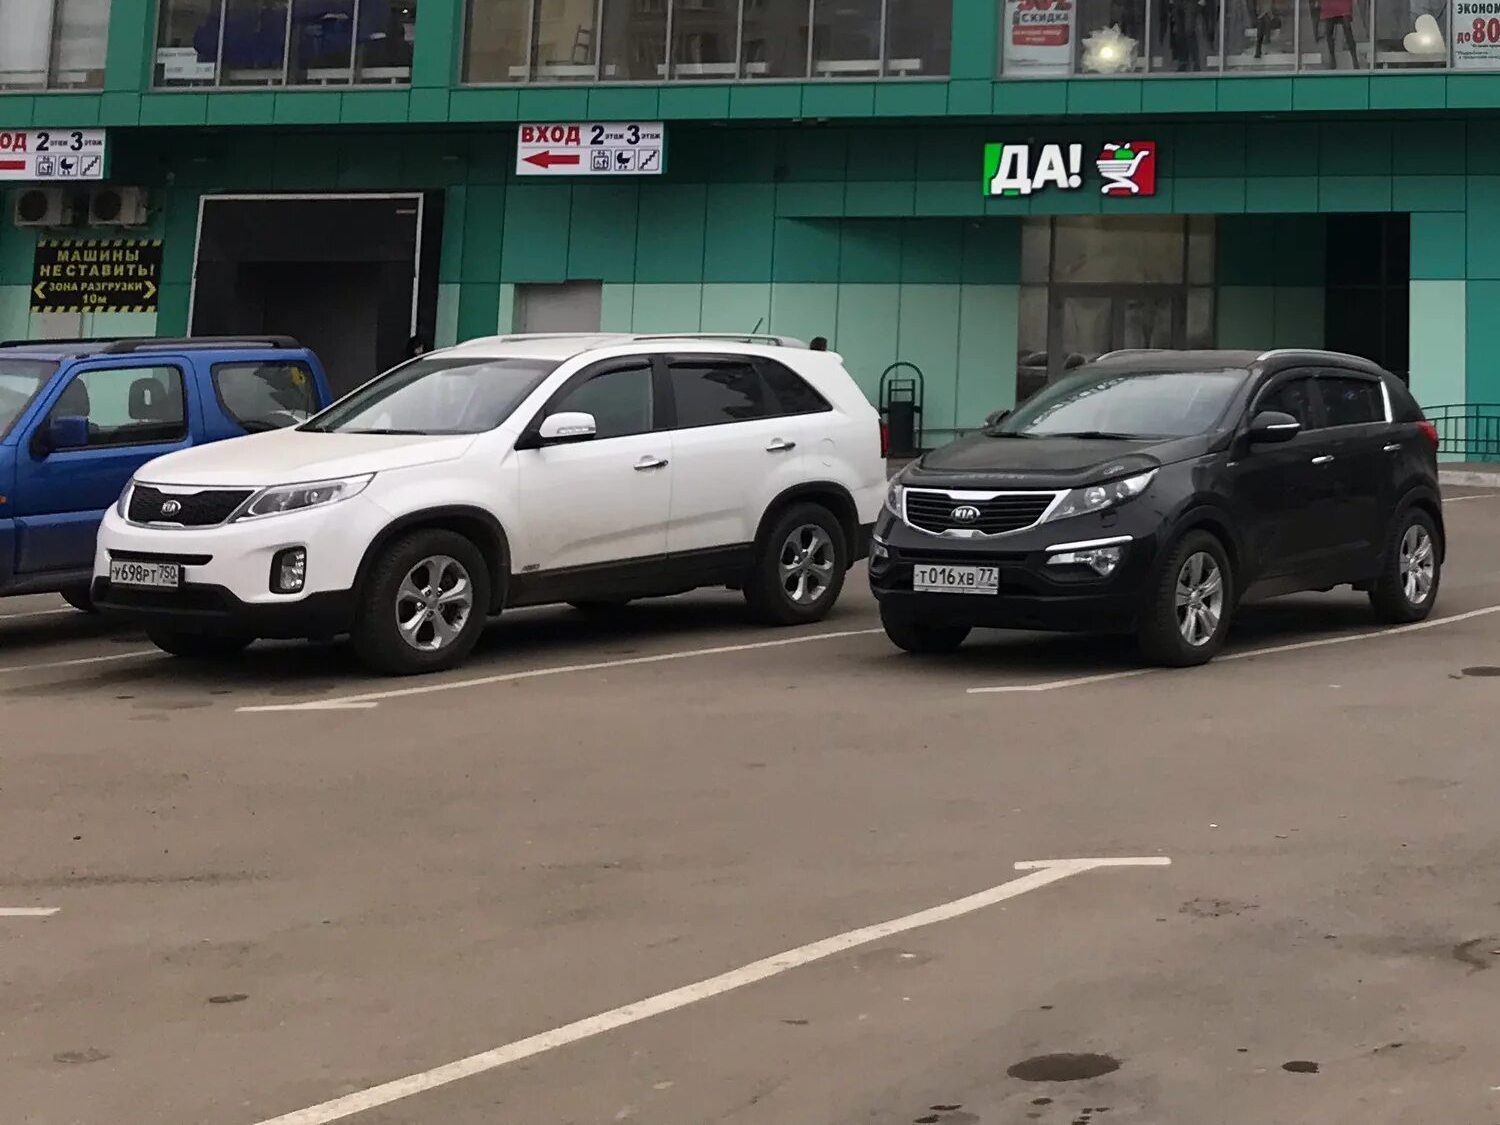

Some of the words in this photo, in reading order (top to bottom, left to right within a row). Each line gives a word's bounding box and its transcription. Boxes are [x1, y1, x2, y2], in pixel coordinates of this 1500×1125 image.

[1457, 32, 1471, 44] до
[36, 132, 50, 151] 2
[70, 131, 83, 151] 3
[521, 125, 581, 146] ВХОД
[590, 125, 604, 145] 2
[626, 125, 640, 145] 3
[991, 143, 1082, 194] ДА!
[57, 249, 139, 262] МАШИНЫ
[49, 282, 77, 292] ЗОНА
[80, 281, 142, 292] РАЗГРУЗКИ
[159, 565, 177, 579] 750
[979, 568, 994, 581] 77
